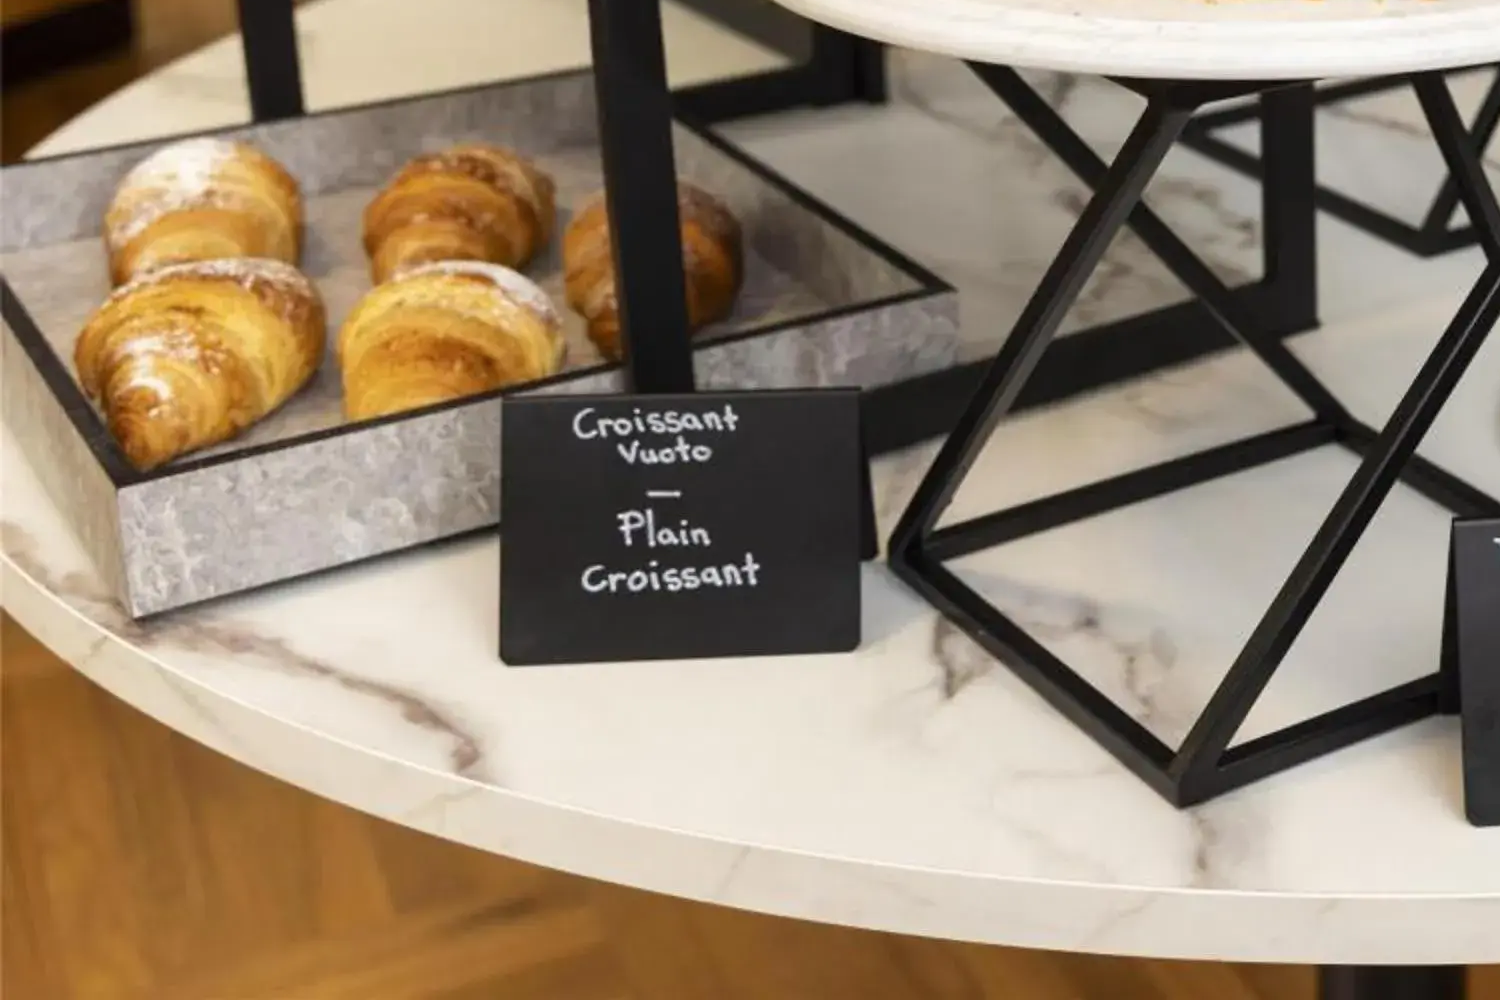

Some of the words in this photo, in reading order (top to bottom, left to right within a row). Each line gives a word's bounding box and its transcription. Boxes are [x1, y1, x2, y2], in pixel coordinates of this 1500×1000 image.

[573, 404, 739, 440] Croissant
[617, 436, 713, 465] Vuoto
[617, 508, 711, 548] Plain
[581, 552, 761, 593] Croissant
